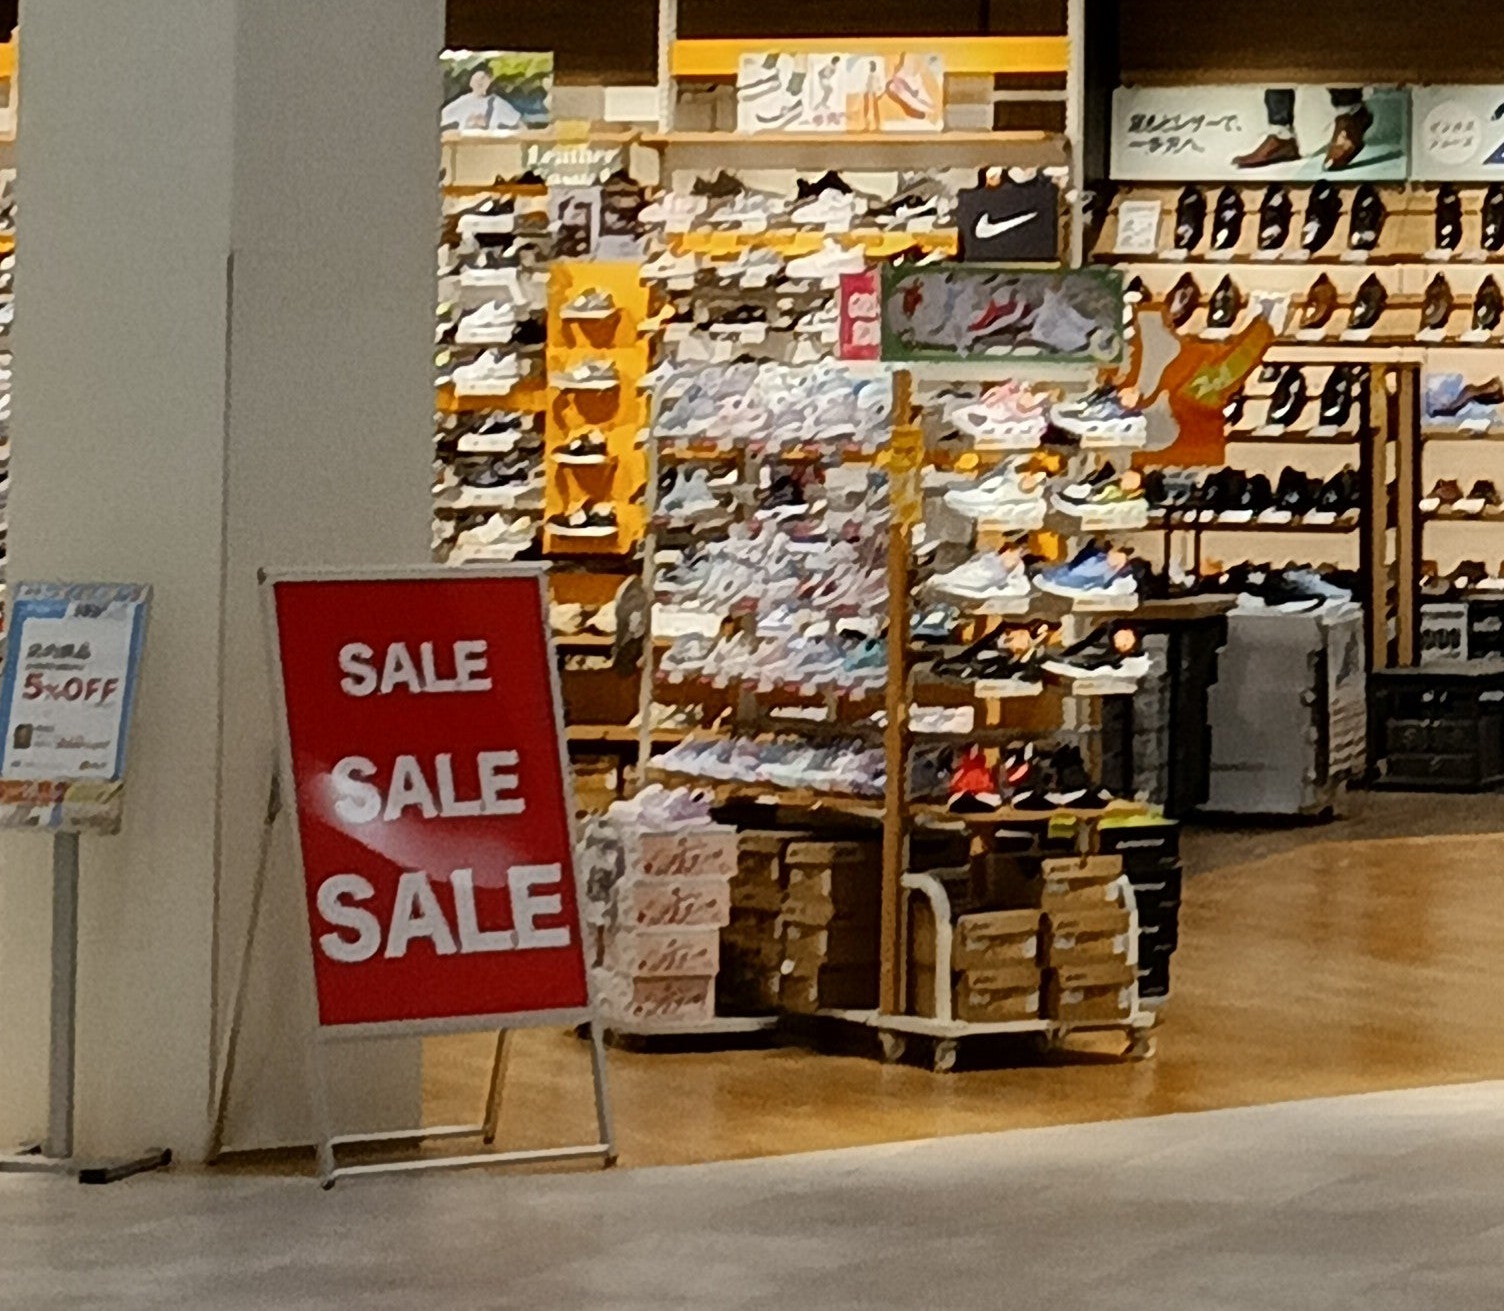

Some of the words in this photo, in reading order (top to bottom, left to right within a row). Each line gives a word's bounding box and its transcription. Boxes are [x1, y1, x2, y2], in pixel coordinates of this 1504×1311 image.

[337, 639, 493, 697] SALE
[330, 749, 526, 824] SALE
[315, 862, 571, 963] SALE
